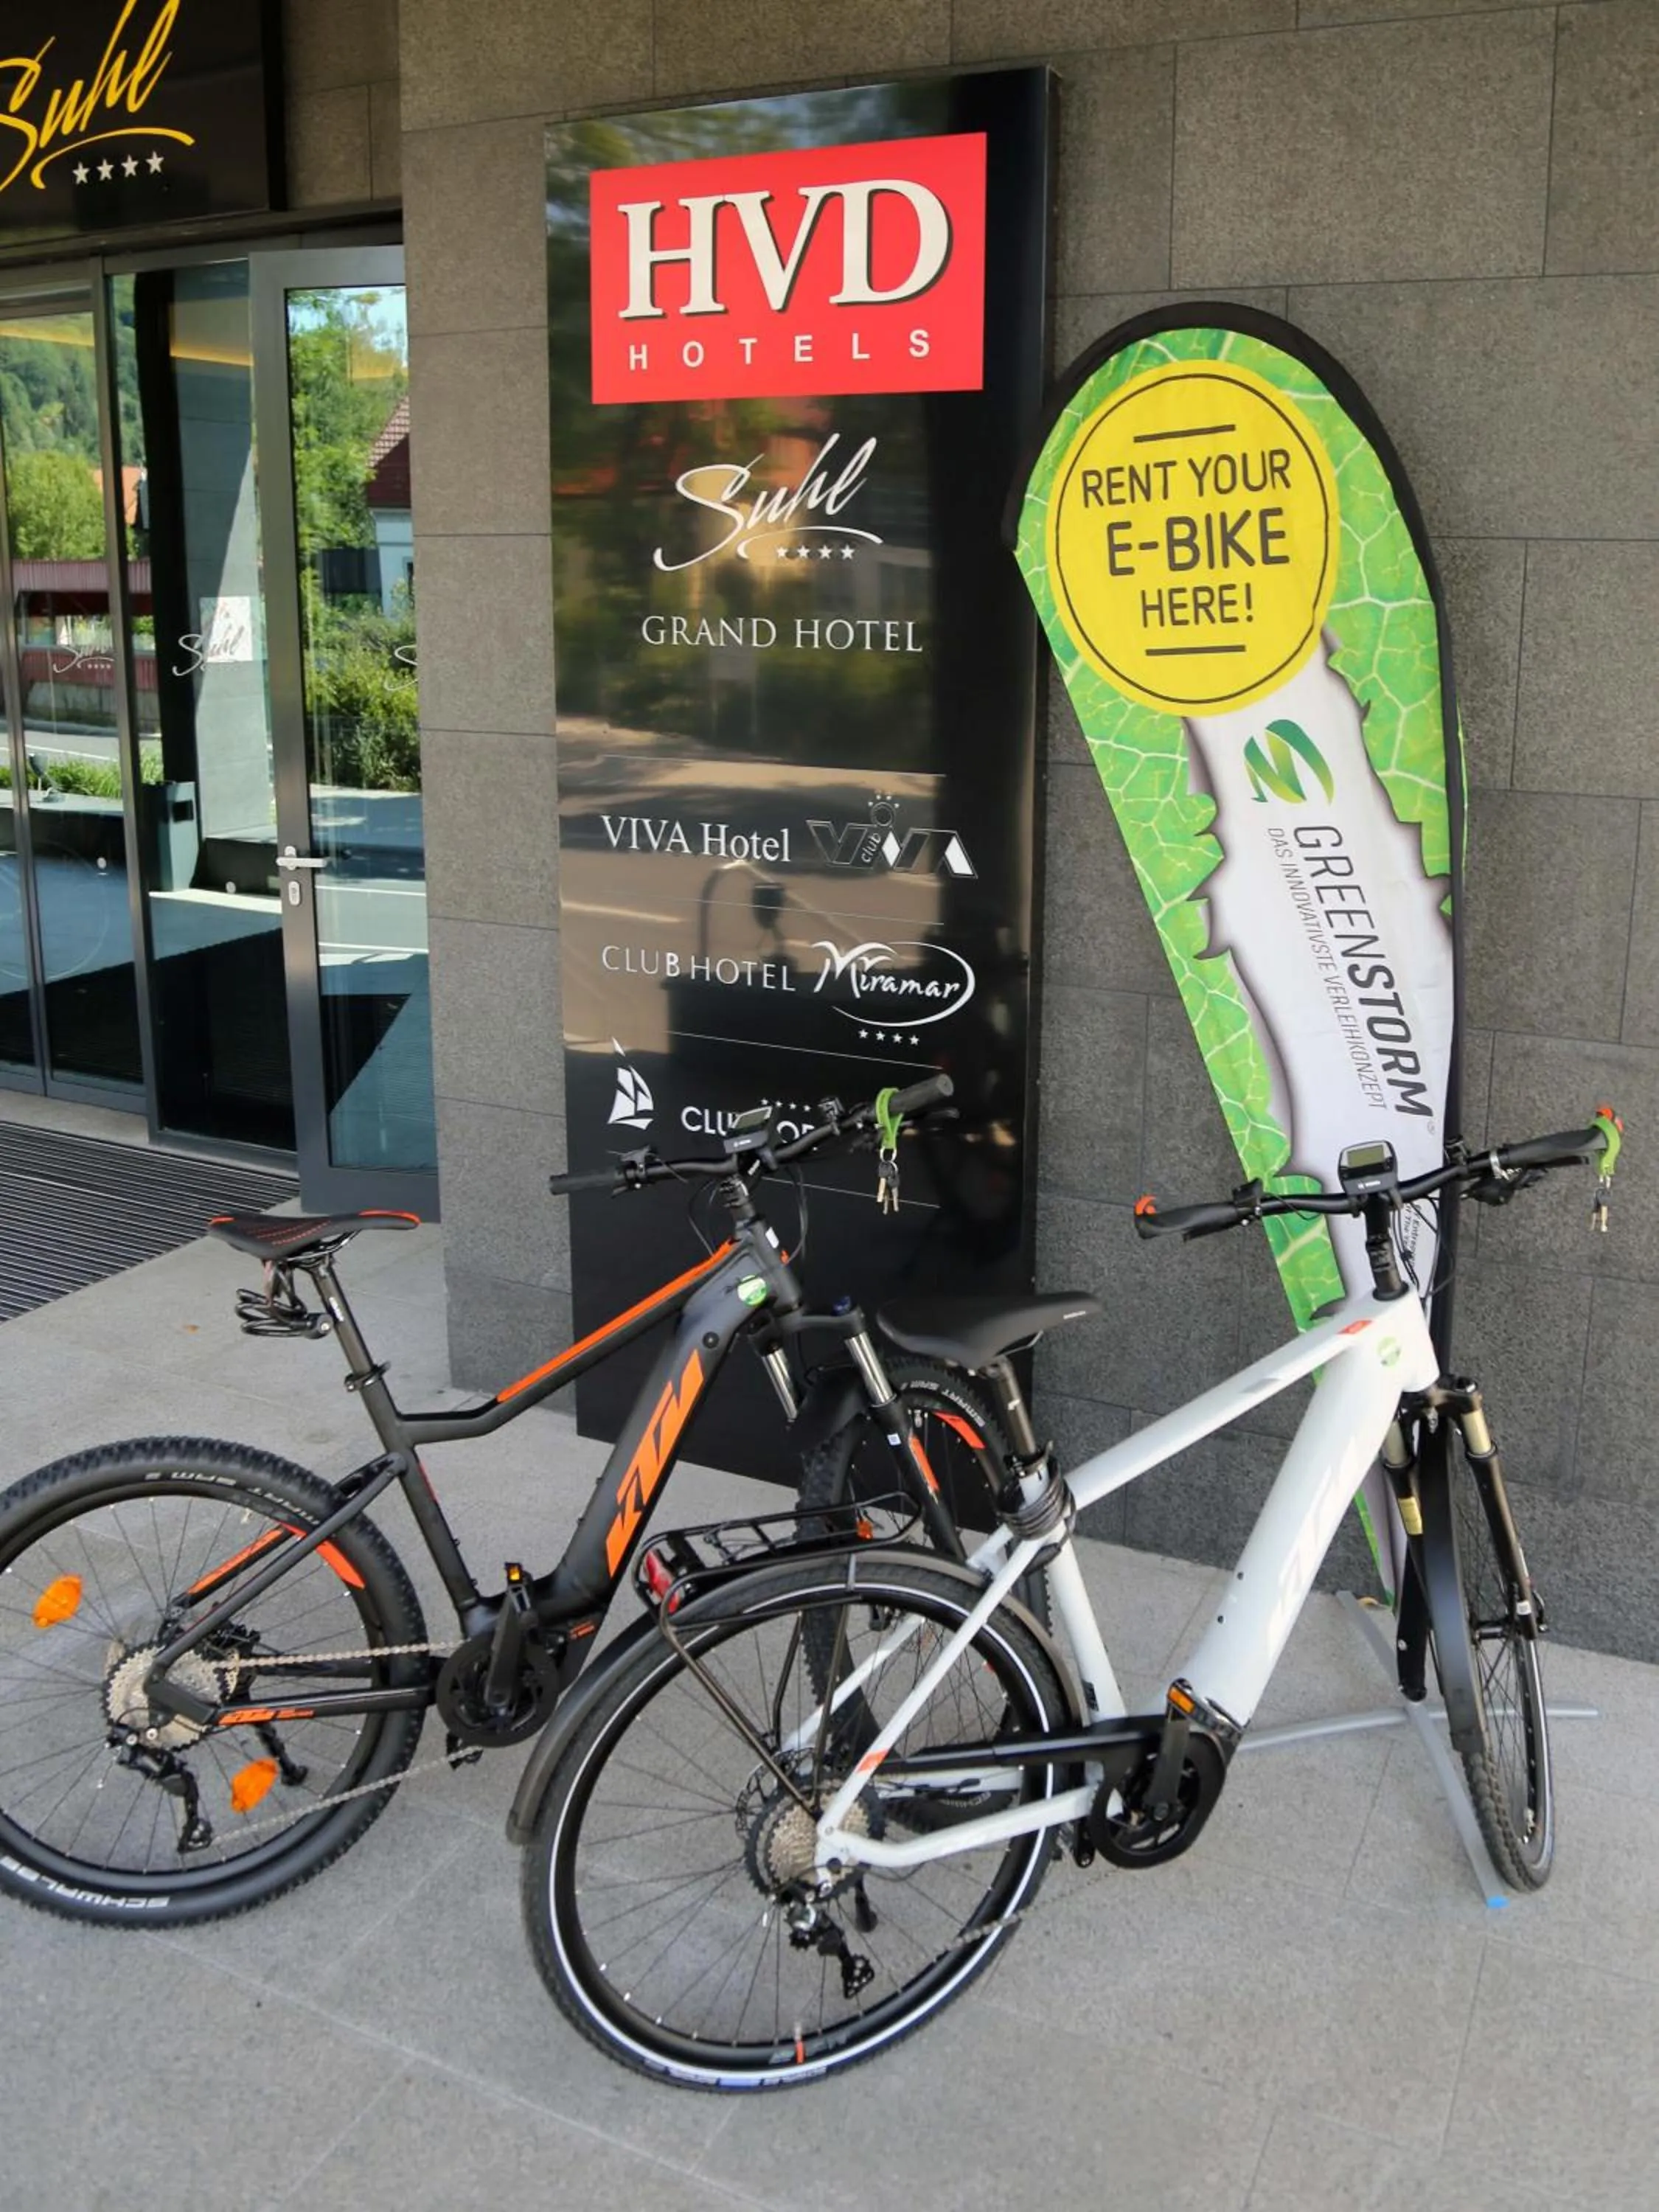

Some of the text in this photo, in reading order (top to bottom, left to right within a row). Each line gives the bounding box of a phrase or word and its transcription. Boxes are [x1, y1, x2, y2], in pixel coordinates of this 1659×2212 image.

[616, 179, 953, 319] HVD
[628, 329, 931, 370] HOTELS
[653, 433, 878, 572] Suhl
[1082, 448, 1292, 509] RENT YOUR
[1106, 507, 1290, 576] E-BIKE
[641, 615, 923, 653] GRAND HOTEL
[1141, 582, 1254, 628] HERE!
[601, 814, 791, 863] VIVA Hotel
[602, 945, 797, 992] CLUB HOTEL
[810, 941, 960, 1000] Miramar
[1267, 827, 1388, 1109] DAS INNOVATIVSTE VERLEIHKONZEPT
[1293, 826, 1433, 1117] GREENSTORM
[681, 1105, 740, 1136] CLU
